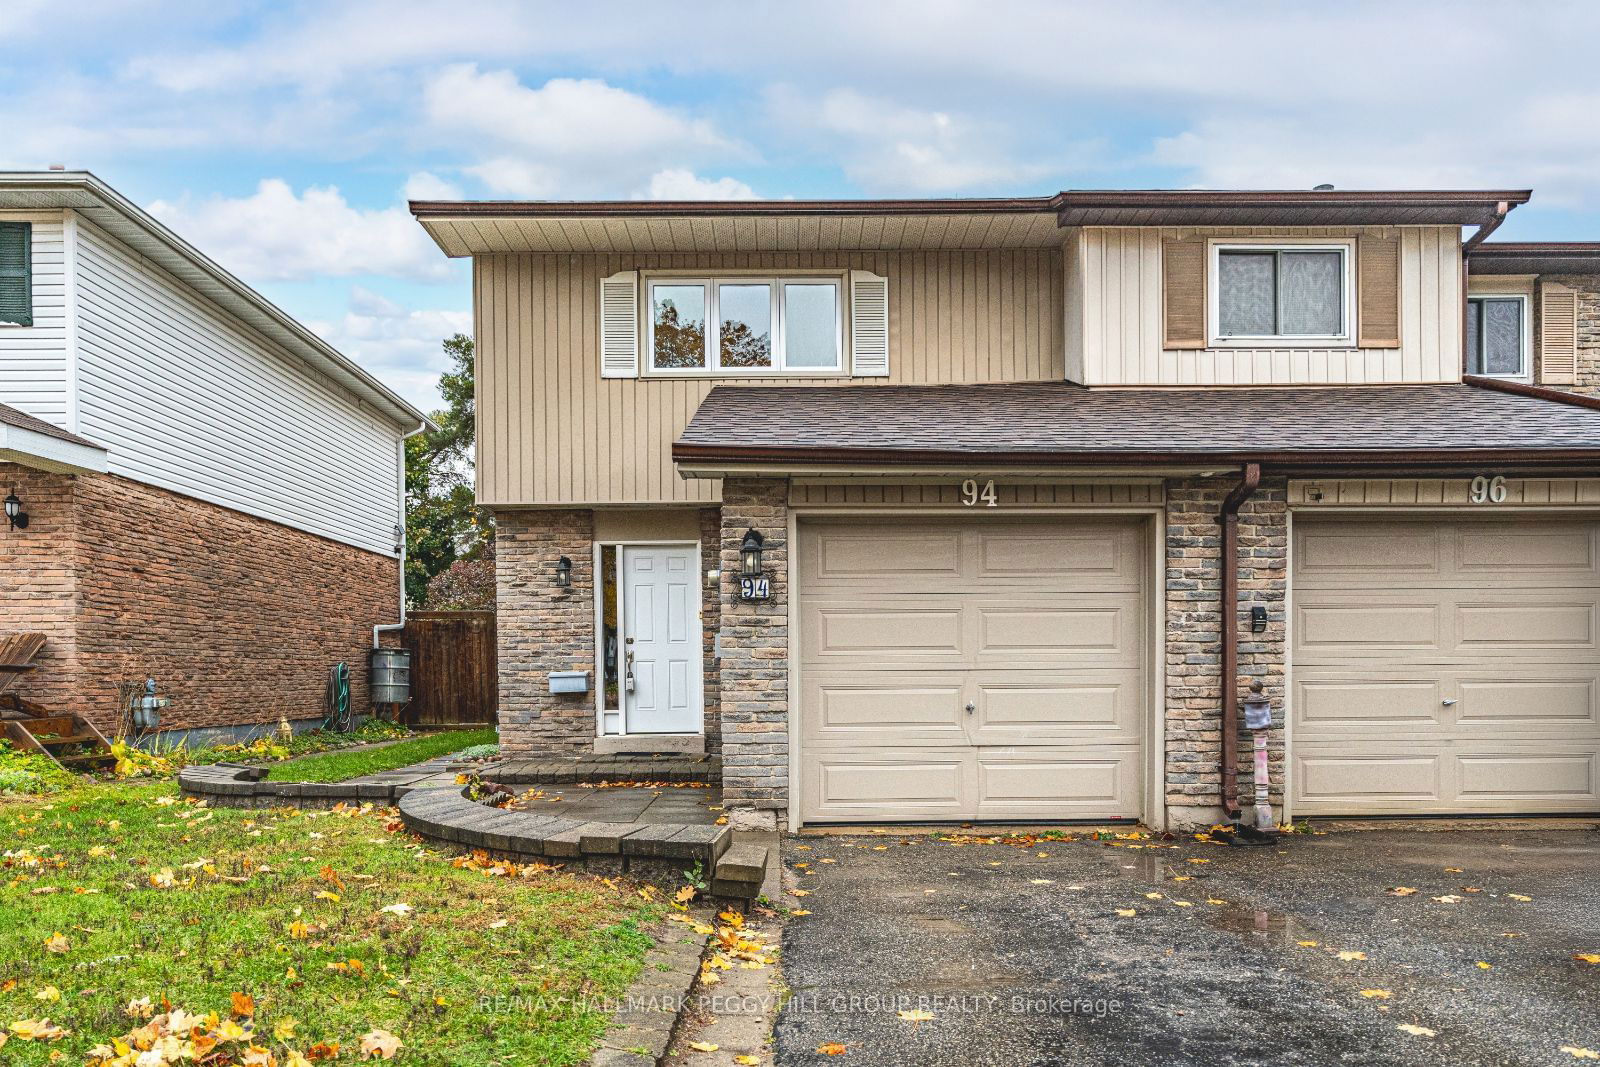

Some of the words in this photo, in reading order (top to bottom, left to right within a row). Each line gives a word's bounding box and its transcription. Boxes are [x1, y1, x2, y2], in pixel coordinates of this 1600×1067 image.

[962, 479, 998, 507] 94
[1471, 475, 1507, 503] 96
[742, 578, 769, 599] 94
